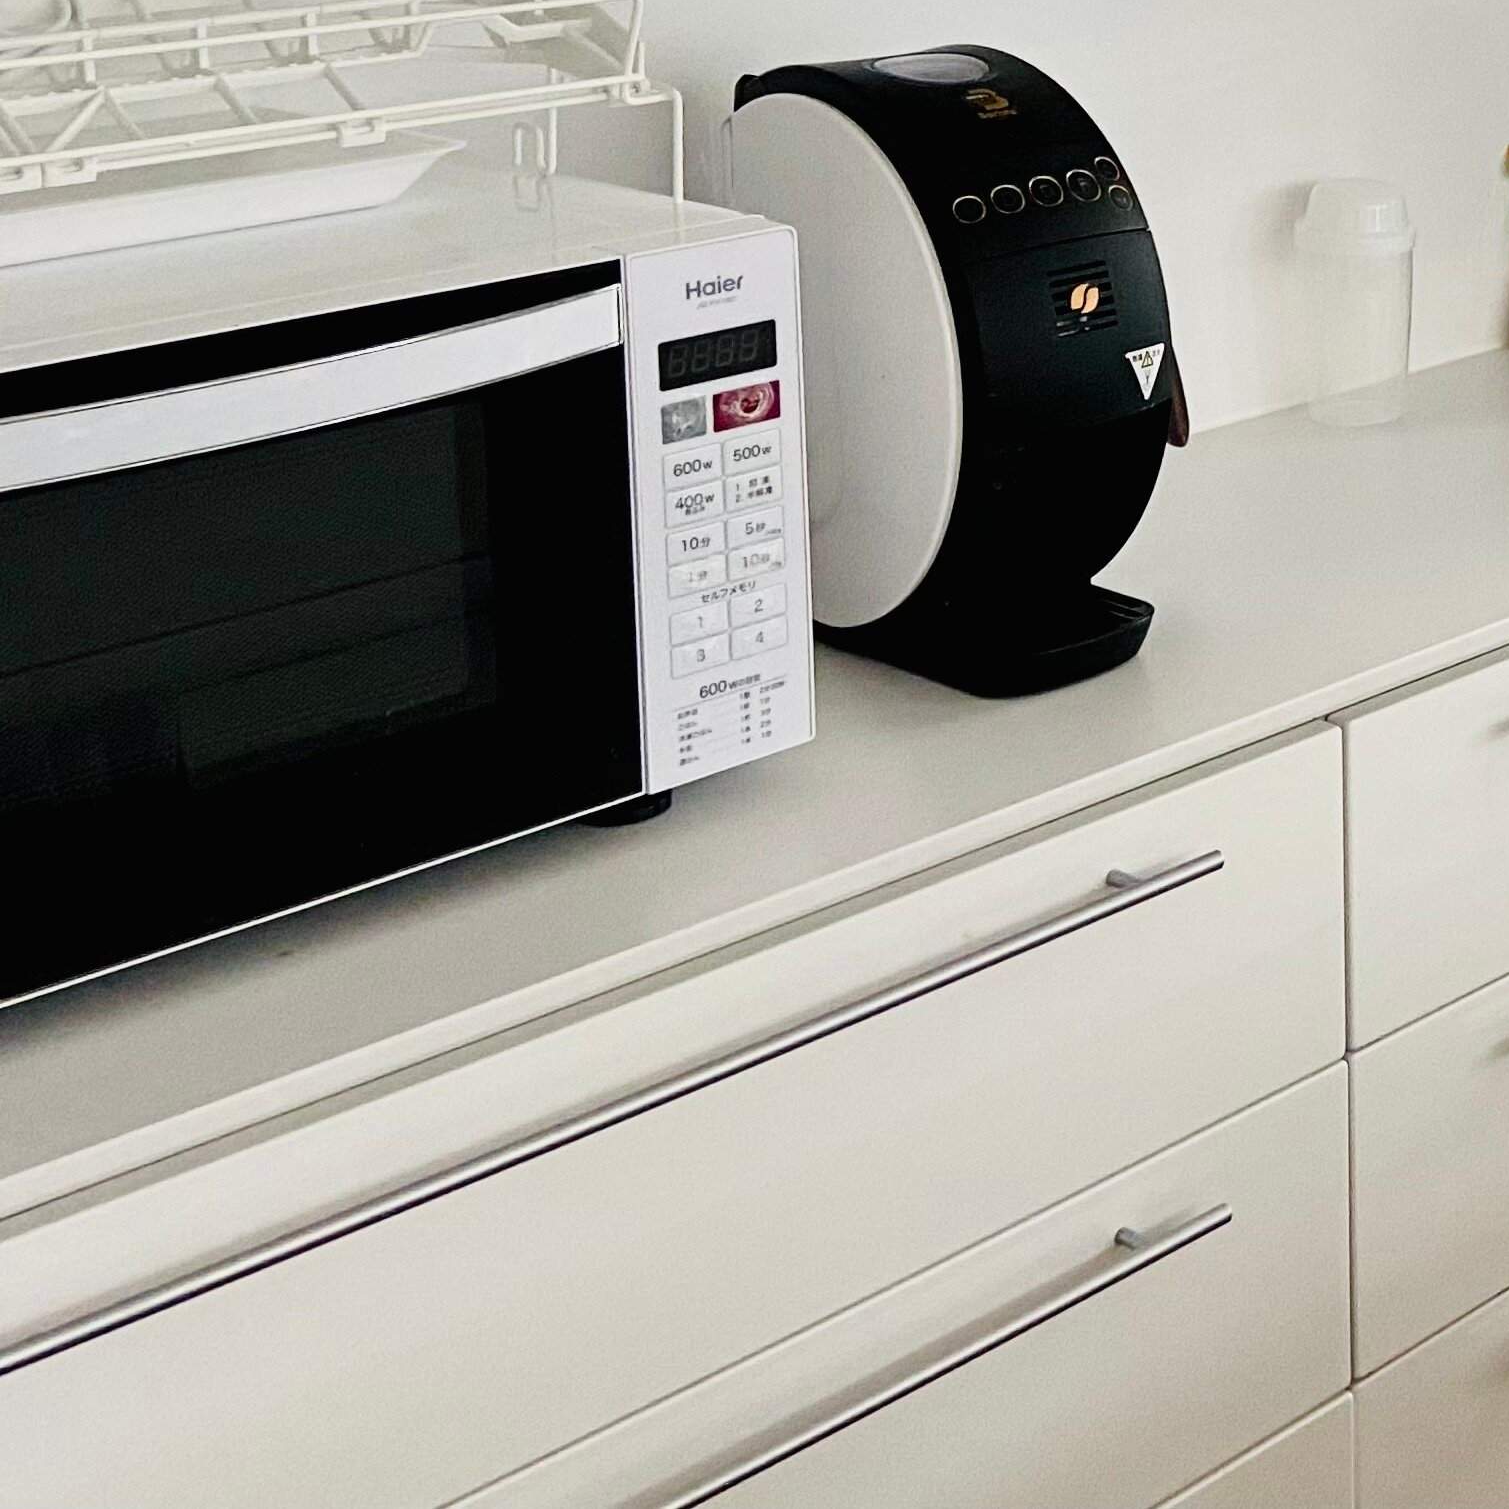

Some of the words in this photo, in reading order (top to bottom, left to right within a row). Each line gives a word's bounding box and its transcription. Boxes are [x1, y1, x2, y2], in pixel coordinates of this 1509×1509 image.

[686, 275, 744, 300] Haier
[754, 598, 763, 613] 2
[755, 631, 764, 644] 4
[696, 648, 706, 663] 3
